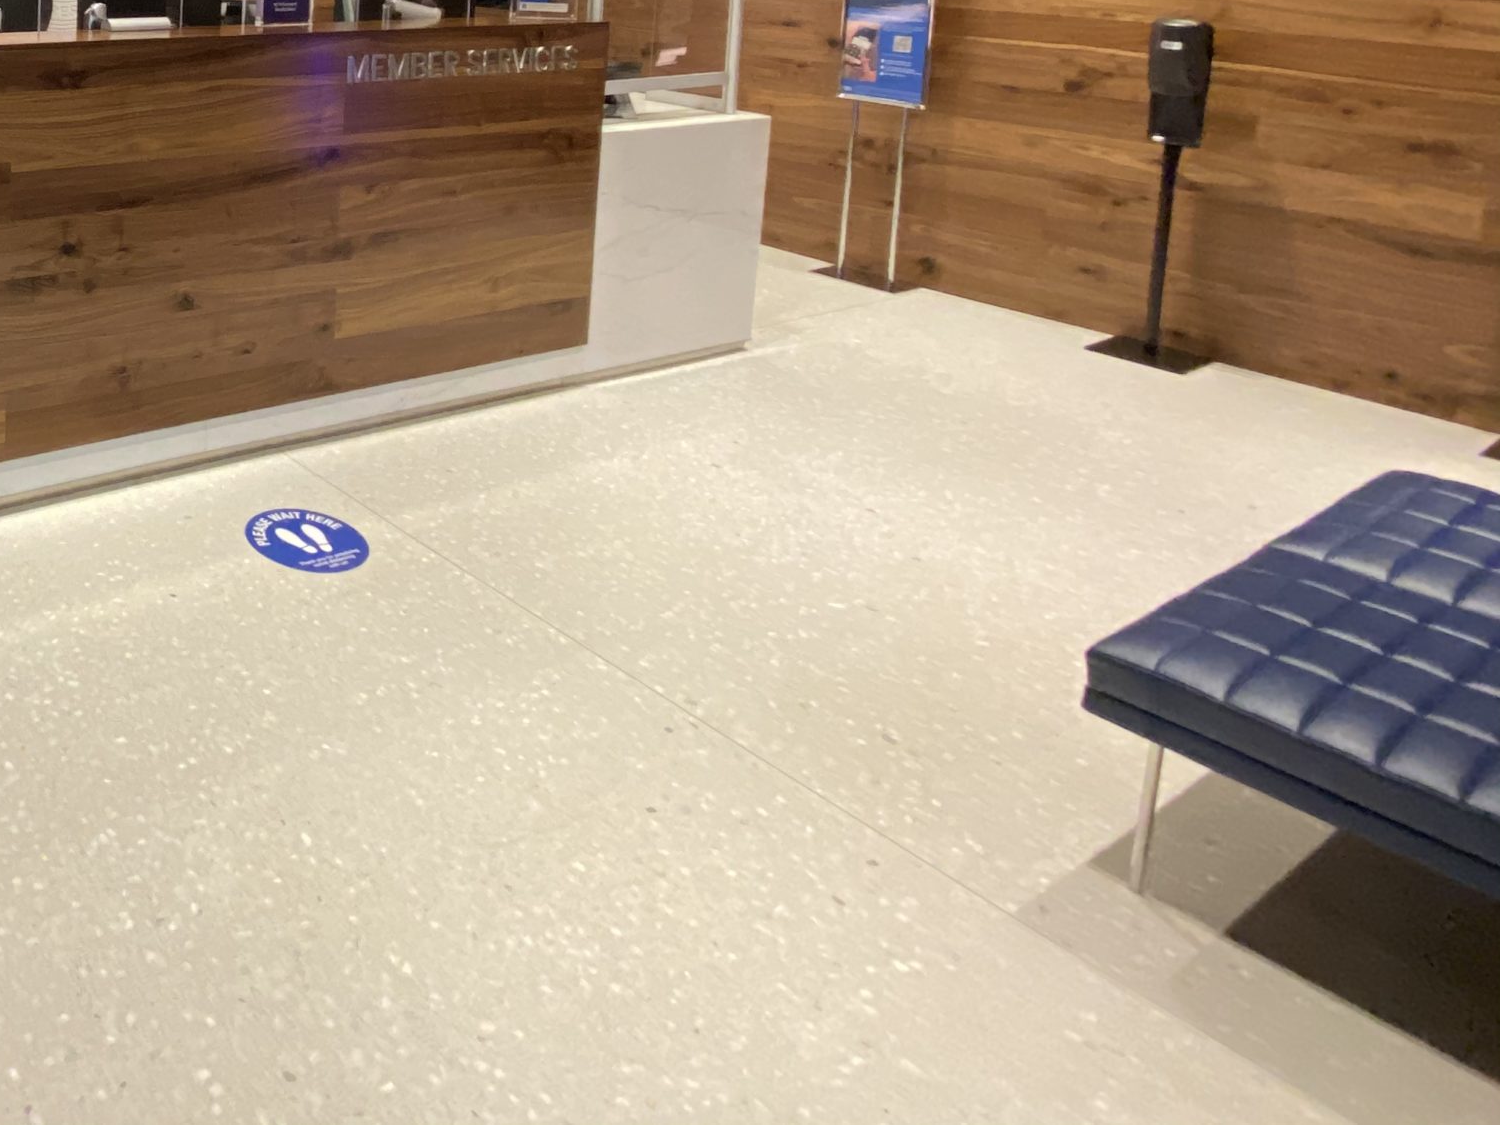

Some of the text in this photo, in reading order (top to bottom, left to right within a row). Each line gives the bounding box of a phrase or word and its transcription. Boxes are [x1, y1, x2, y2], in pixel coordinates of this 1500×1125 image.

[347, 45, 579, 84] MEMBER SERVICES
[252, 511, 343, 546] PLEASE WAIT HERE
